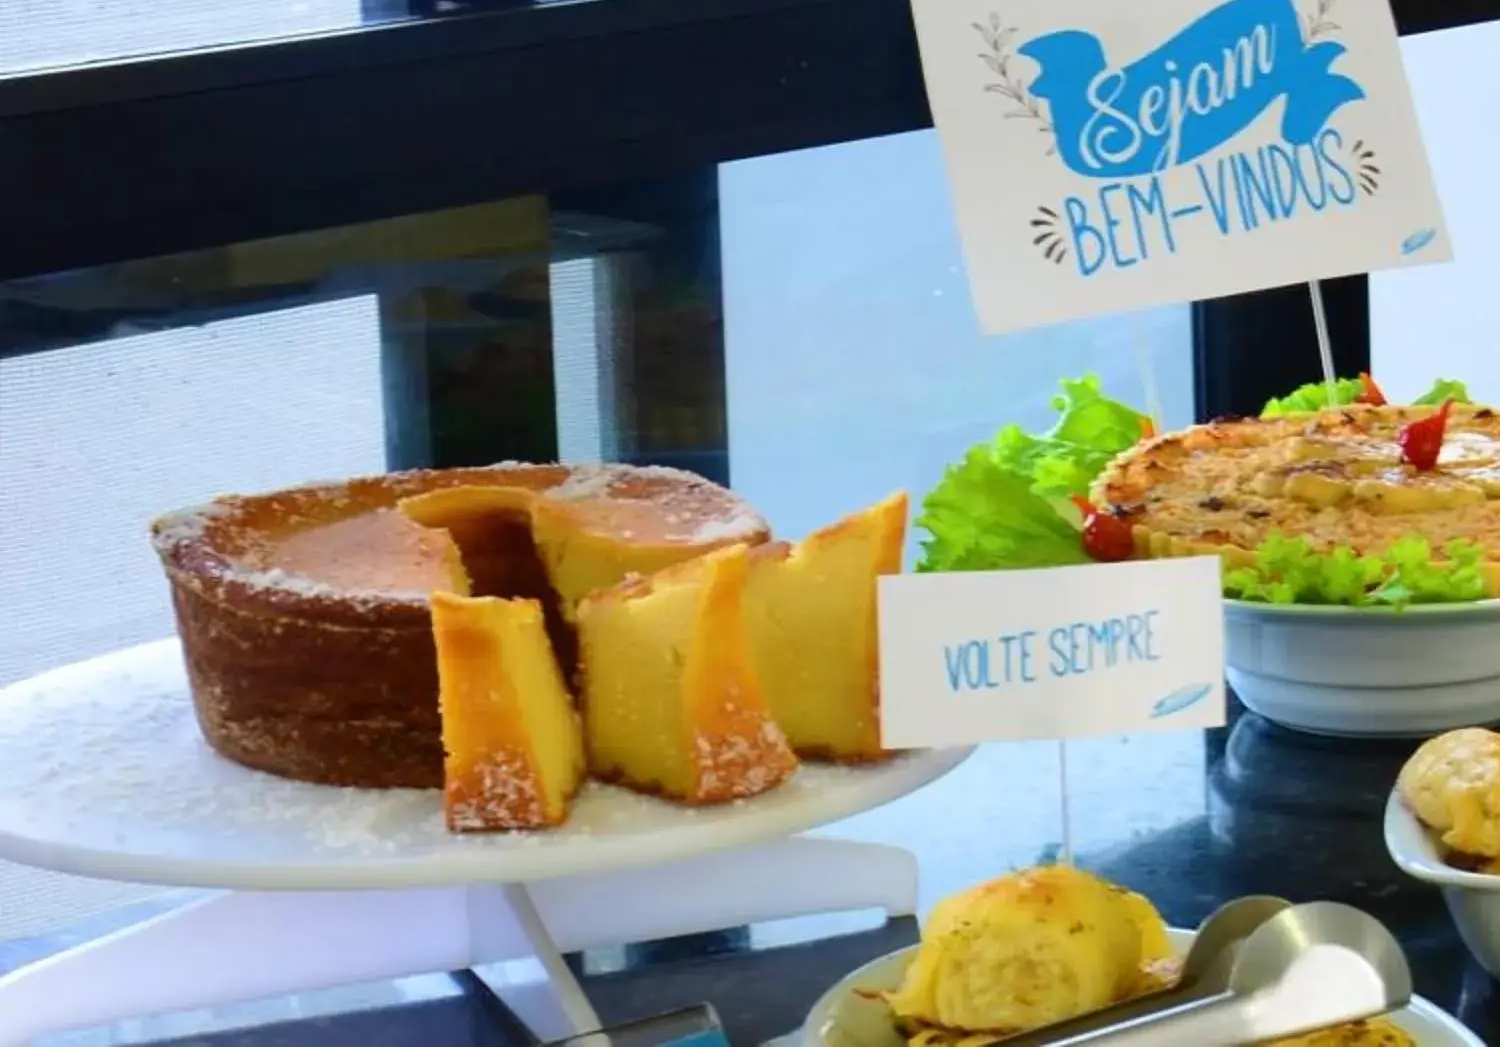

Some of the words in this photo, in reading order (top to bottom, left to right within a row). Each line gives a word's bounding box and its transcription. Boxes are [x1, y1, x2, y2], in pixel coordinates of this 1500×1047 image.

[1079, 22, 1278, 173] Sejam
[1065, 129, 1356, 276] BEM-VINDOS
[944, 630, 1037, 691] VOLTE
[1049, 609, 1162, 677] SEMPRE
